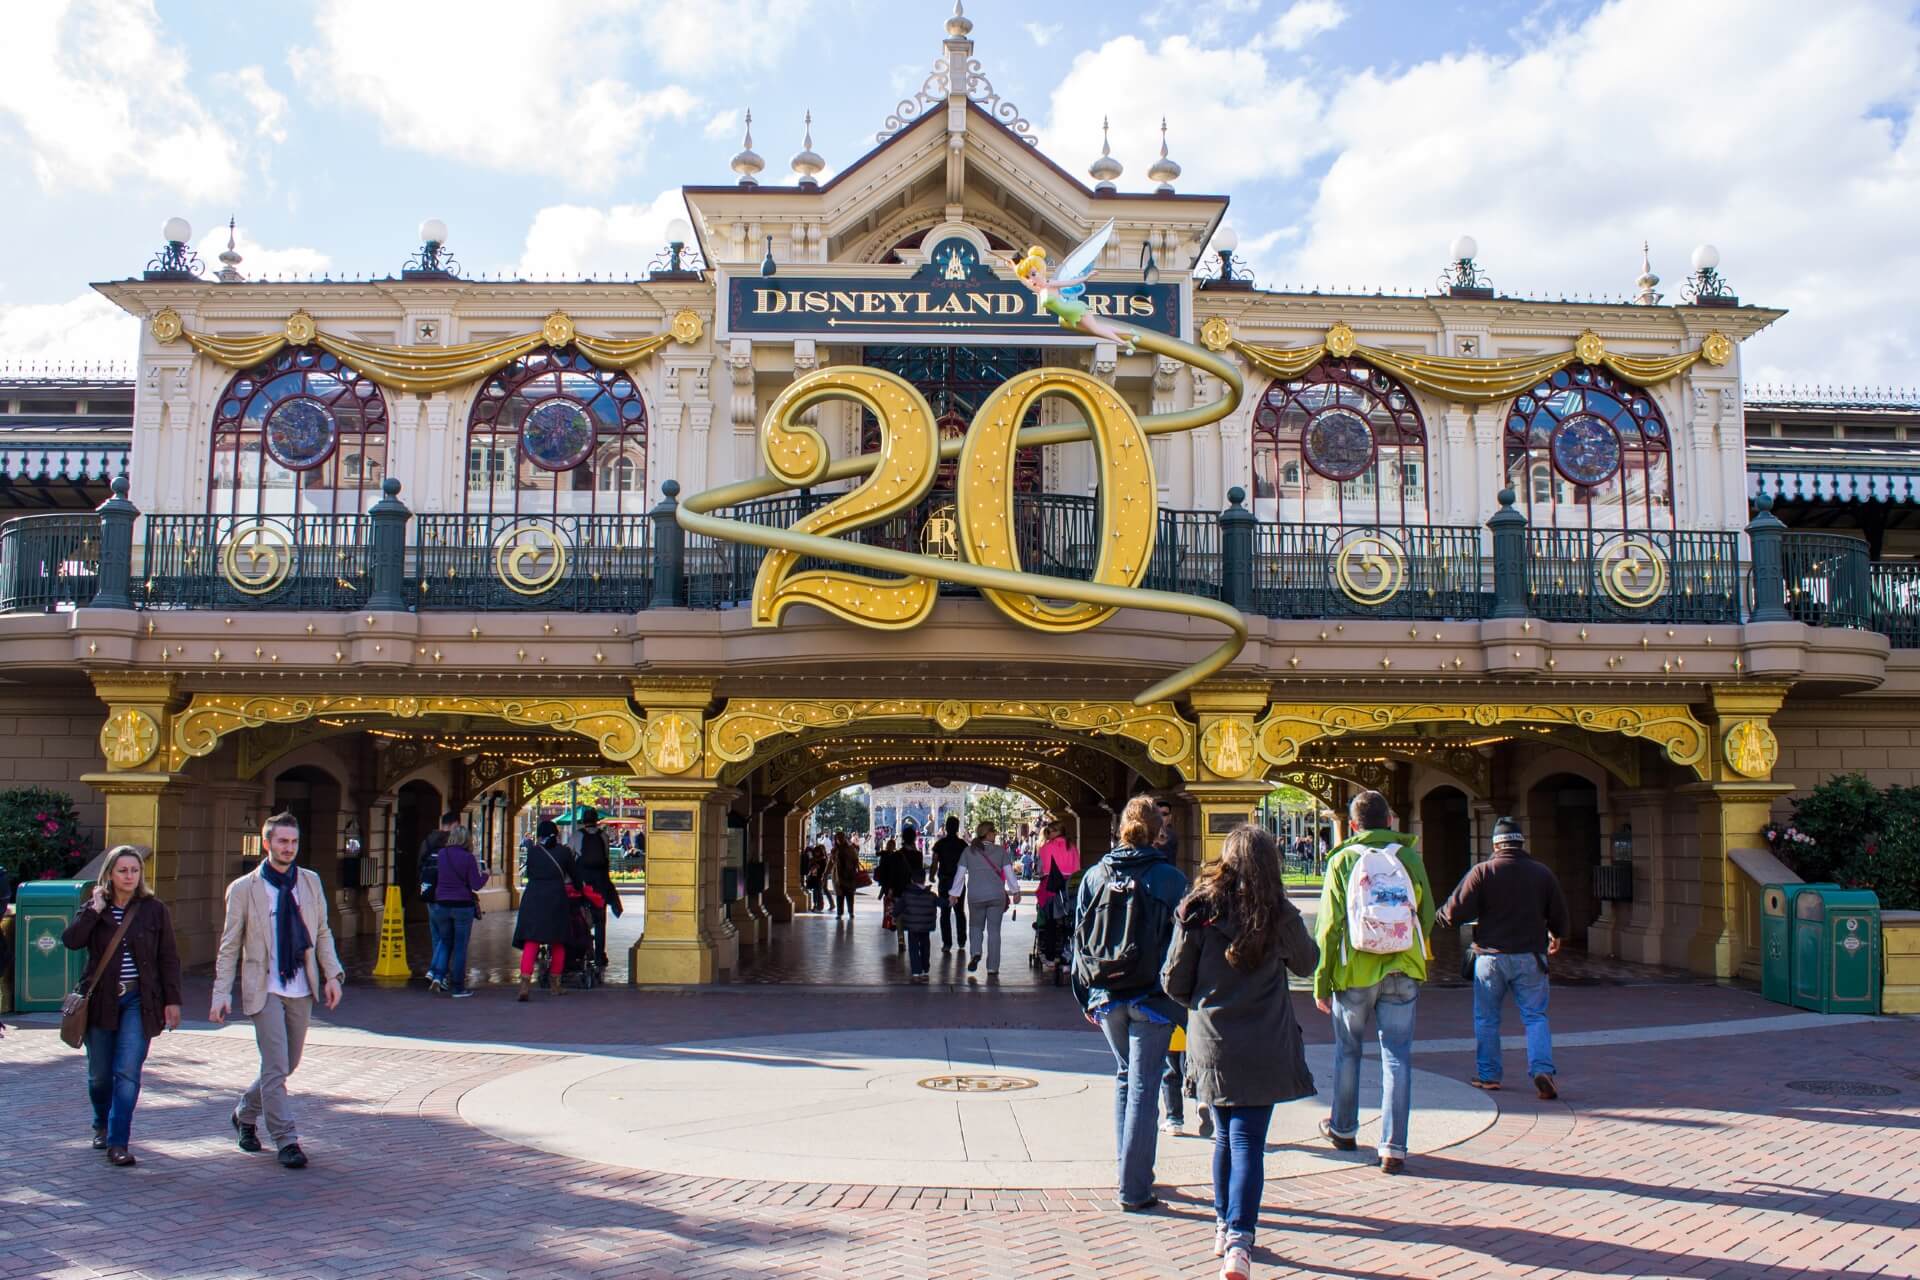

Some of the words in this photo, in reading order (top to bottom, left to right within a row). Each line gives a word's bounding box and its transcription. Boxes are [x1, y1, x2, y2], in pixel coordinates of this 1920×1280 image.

[752, 289, 1024, 315] DISNEYLAND
[1031, 291, 1155, 317] RIS
[751, 364, 1157, 633] 20
